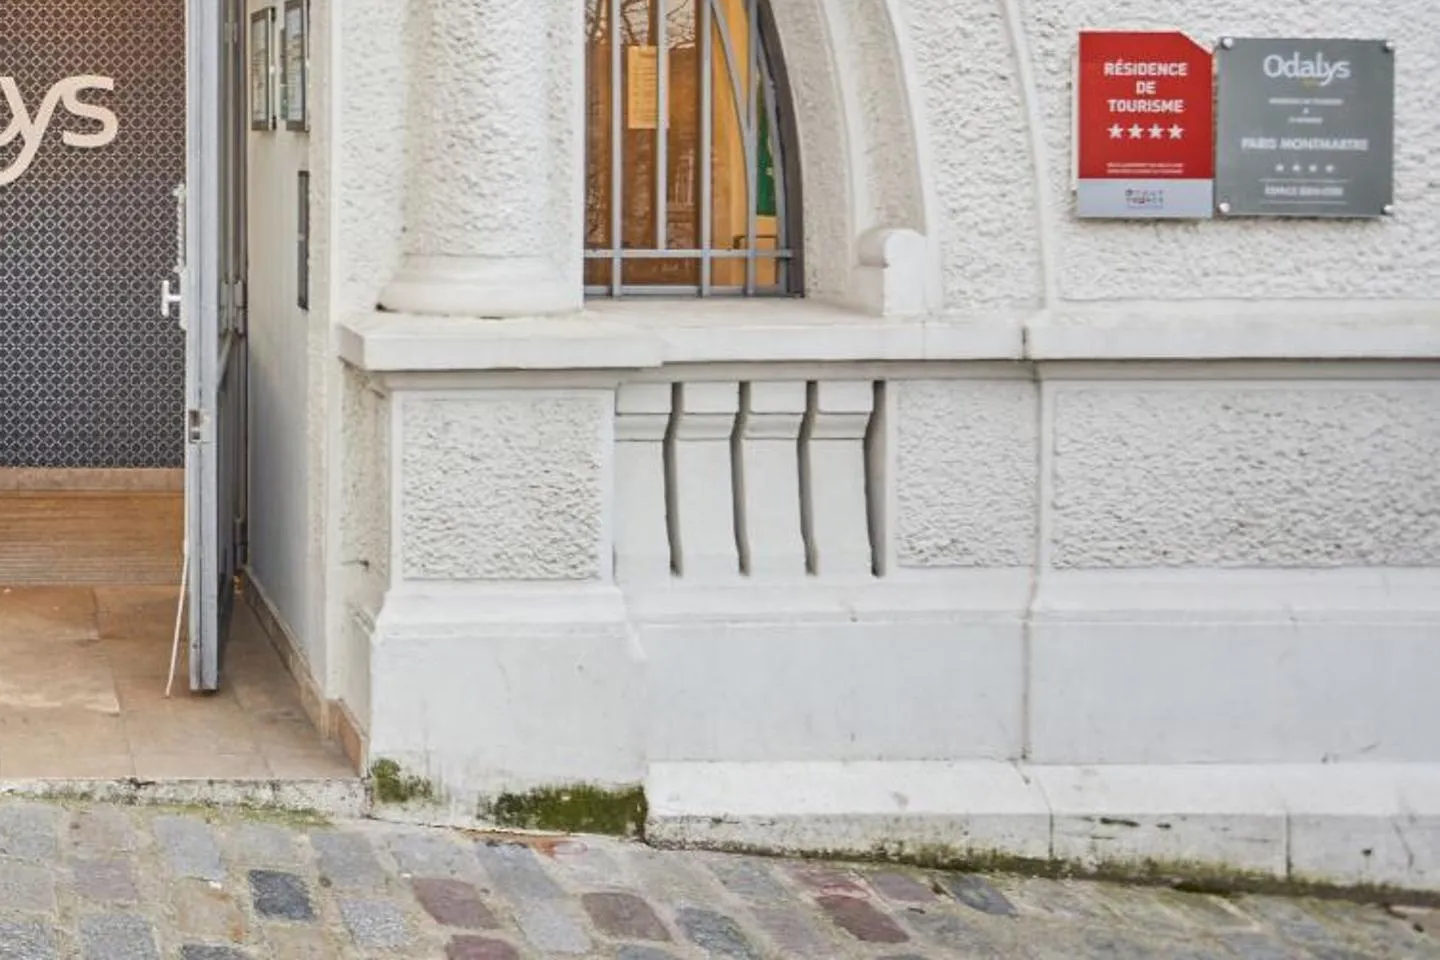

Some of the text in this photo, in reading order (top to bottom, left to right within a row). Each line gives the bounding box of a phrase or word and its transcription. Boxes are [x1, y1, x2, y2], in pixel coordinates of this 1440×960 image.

[1103, 58, 1189, 77] RÉSIDENCE
[1262, 51, 1352, 87] Odalys
[1135, 80, 1157, 96] DE
[1107, 99, 1185, 114] TOURISME
